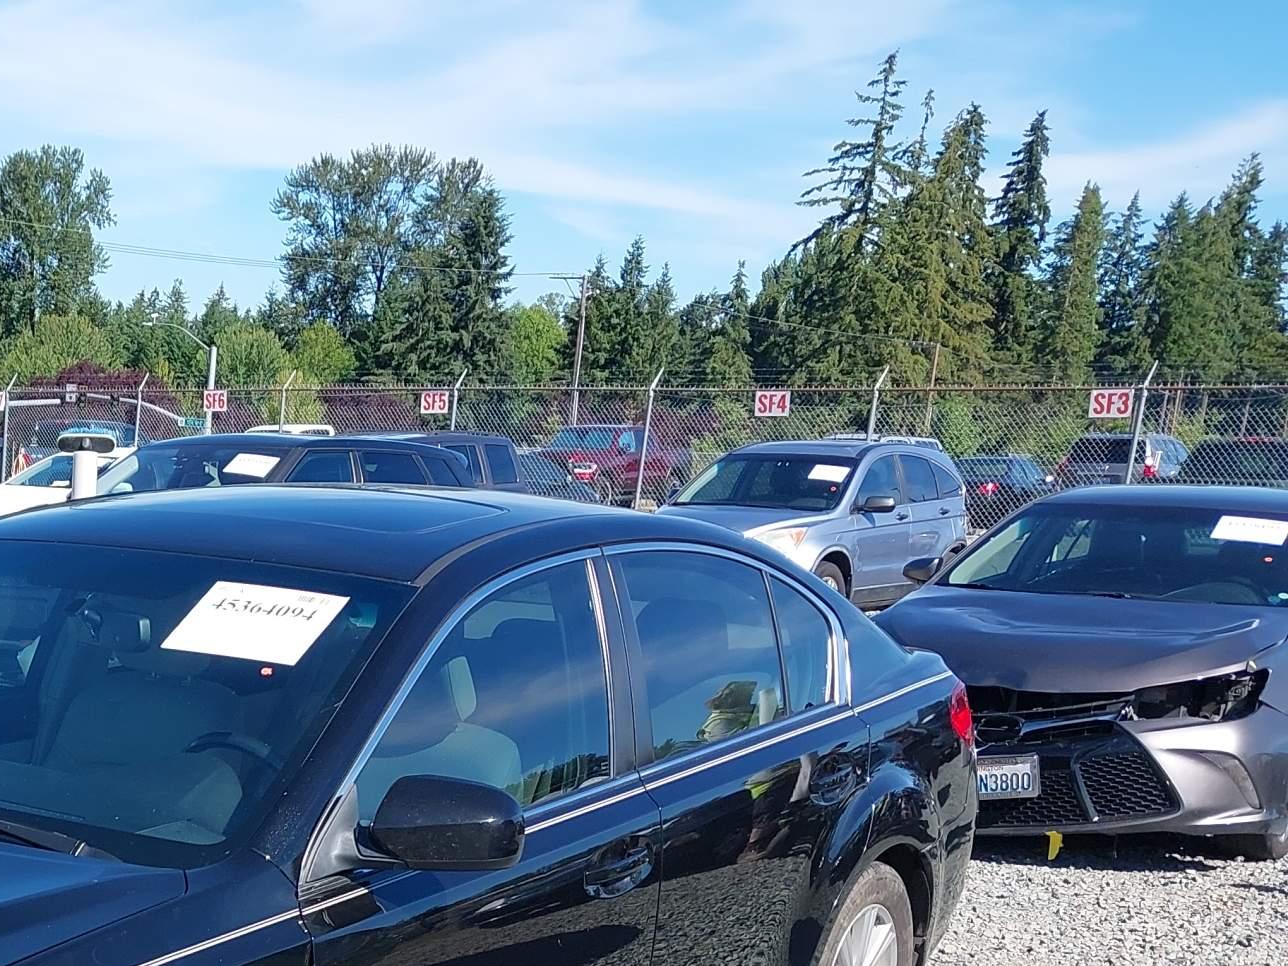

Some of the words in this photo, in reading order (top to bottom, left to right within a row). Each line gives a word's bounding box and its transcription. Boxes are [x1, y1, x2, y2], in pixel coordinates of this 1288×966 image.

[205, 393, 225, 409] SF6
[423, 393, 446, 411] SF5
[757, 394, 787, 414] SF4
[1093, 392, 1129, 415] SF3
[212, 597, 318, 621] 45364094
